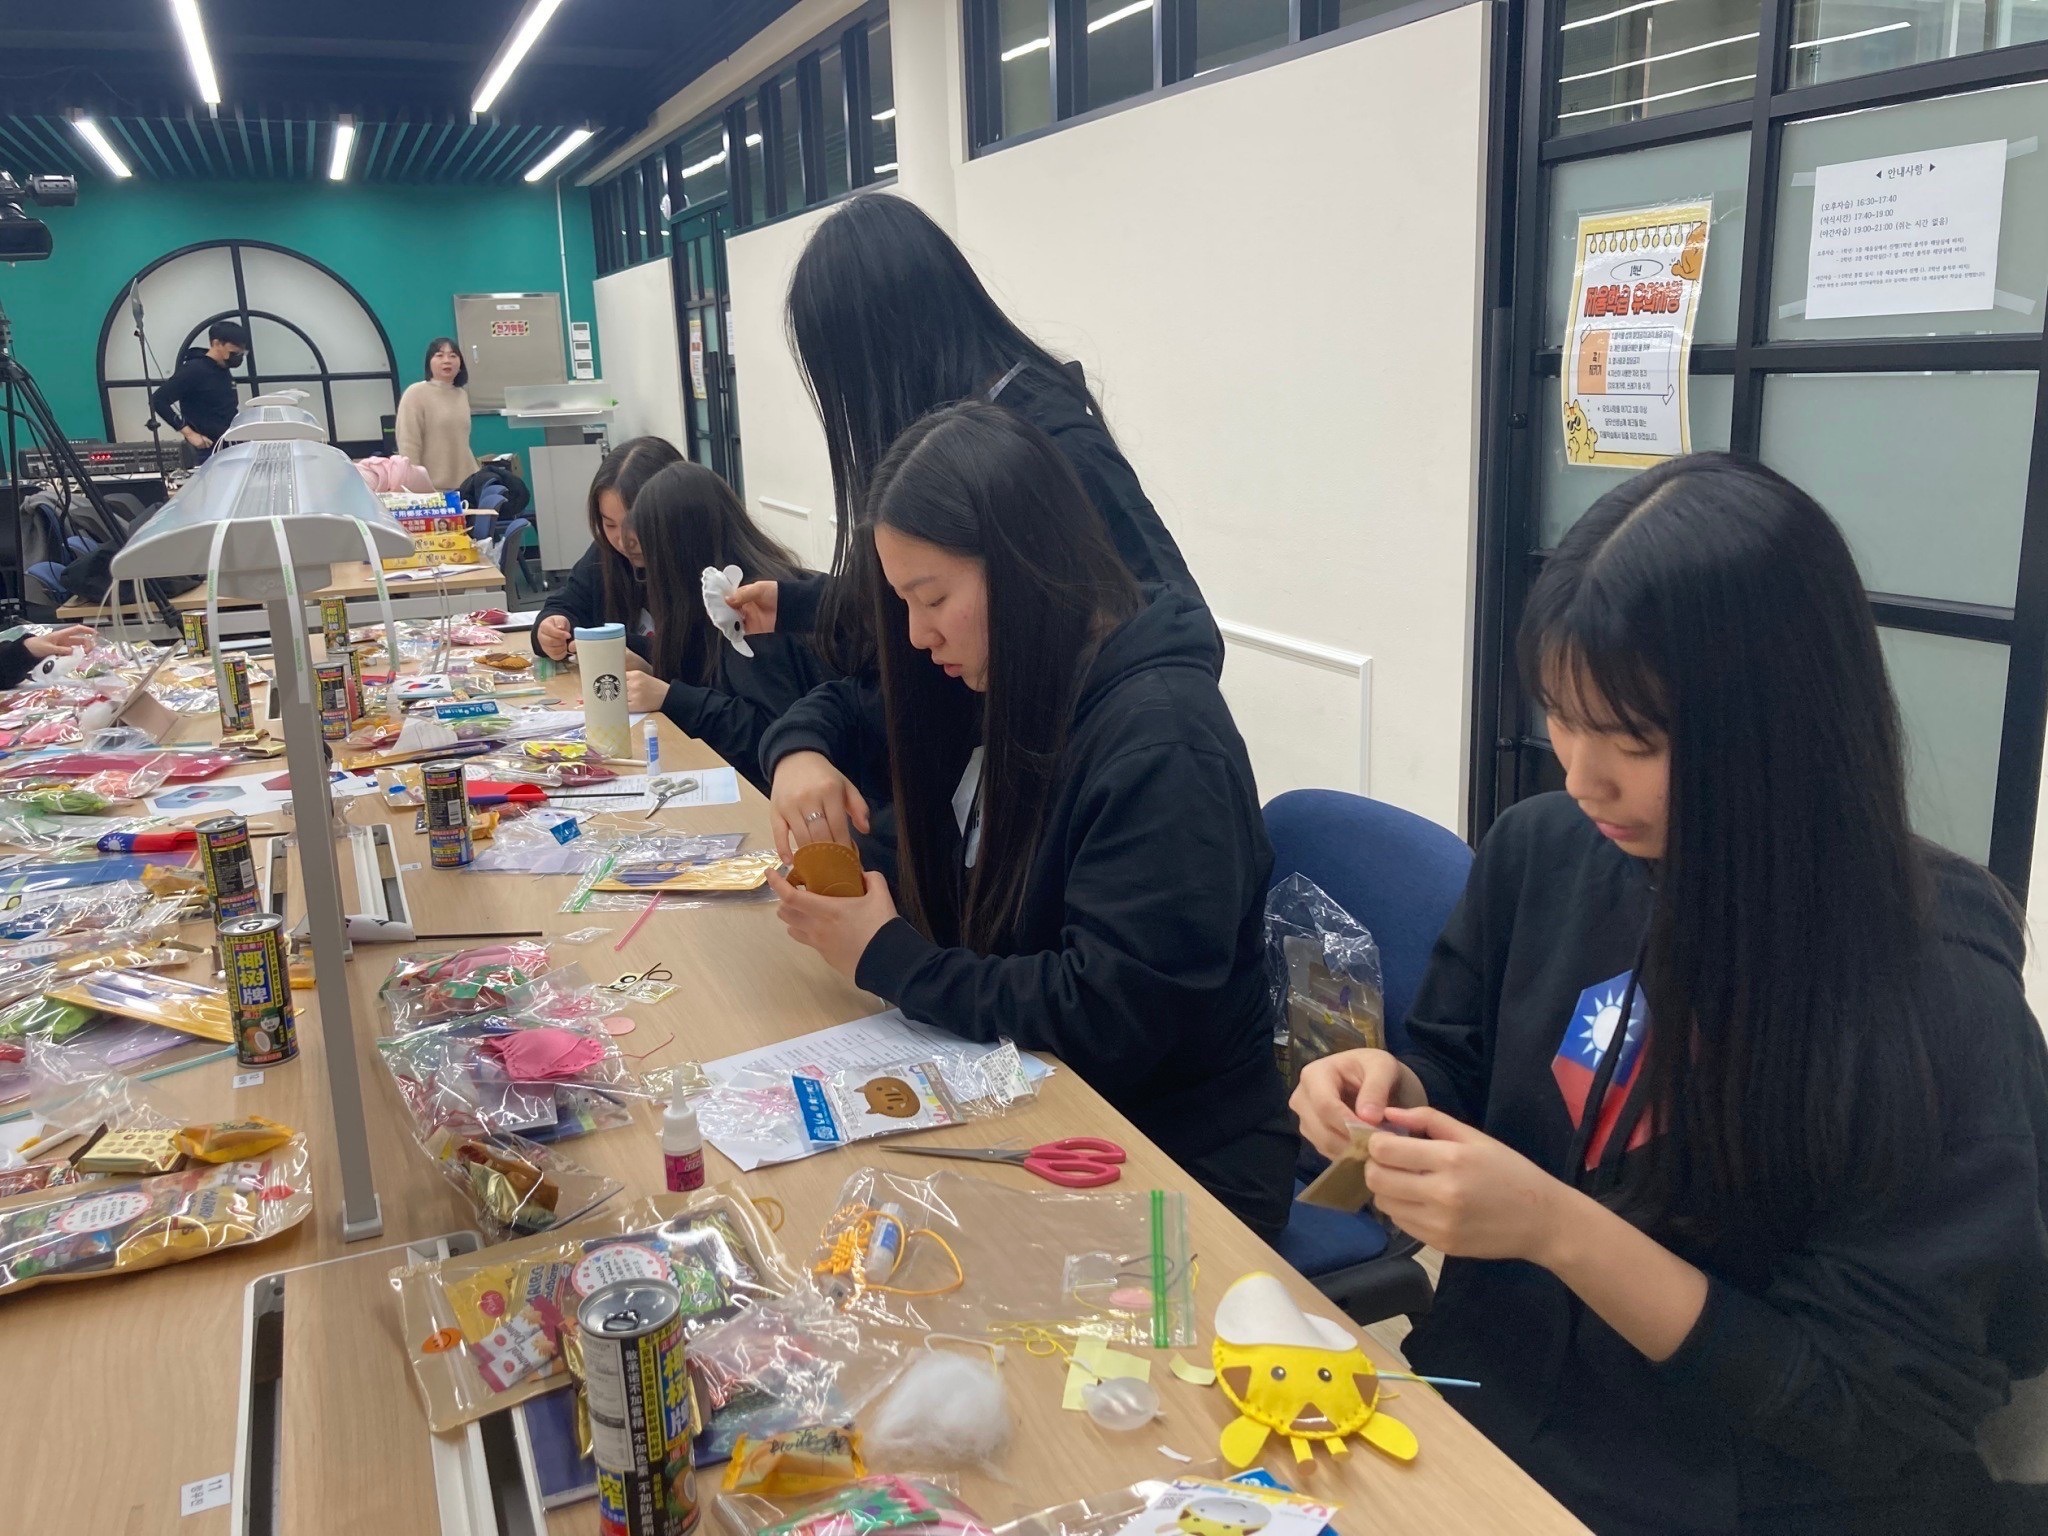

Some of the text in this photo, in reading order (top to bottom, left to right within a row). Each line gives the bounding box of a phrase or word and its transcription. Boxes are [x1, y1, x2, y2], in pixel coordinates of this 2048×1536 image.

[1887, 163, 1924, 180] 안내사항
[1821, 194, 1897, 213] (오후자습) 16:30~17:40
[1819, 216, 1949, 239] (야간자습) 19:00~21:00 (쉬는 시간 없음)
[1820, 208, 1894, 226] (석식시간) 17:40~19:00
[1631, 280, 1684, 315] 유의사항
[496, 324, 525, 334] 전기위험
[237, 950, 269, 1005] 椰树牌
[624, 1349, 655, 1536] 敢承诺不加香精 不加色素 不加防腐剂
